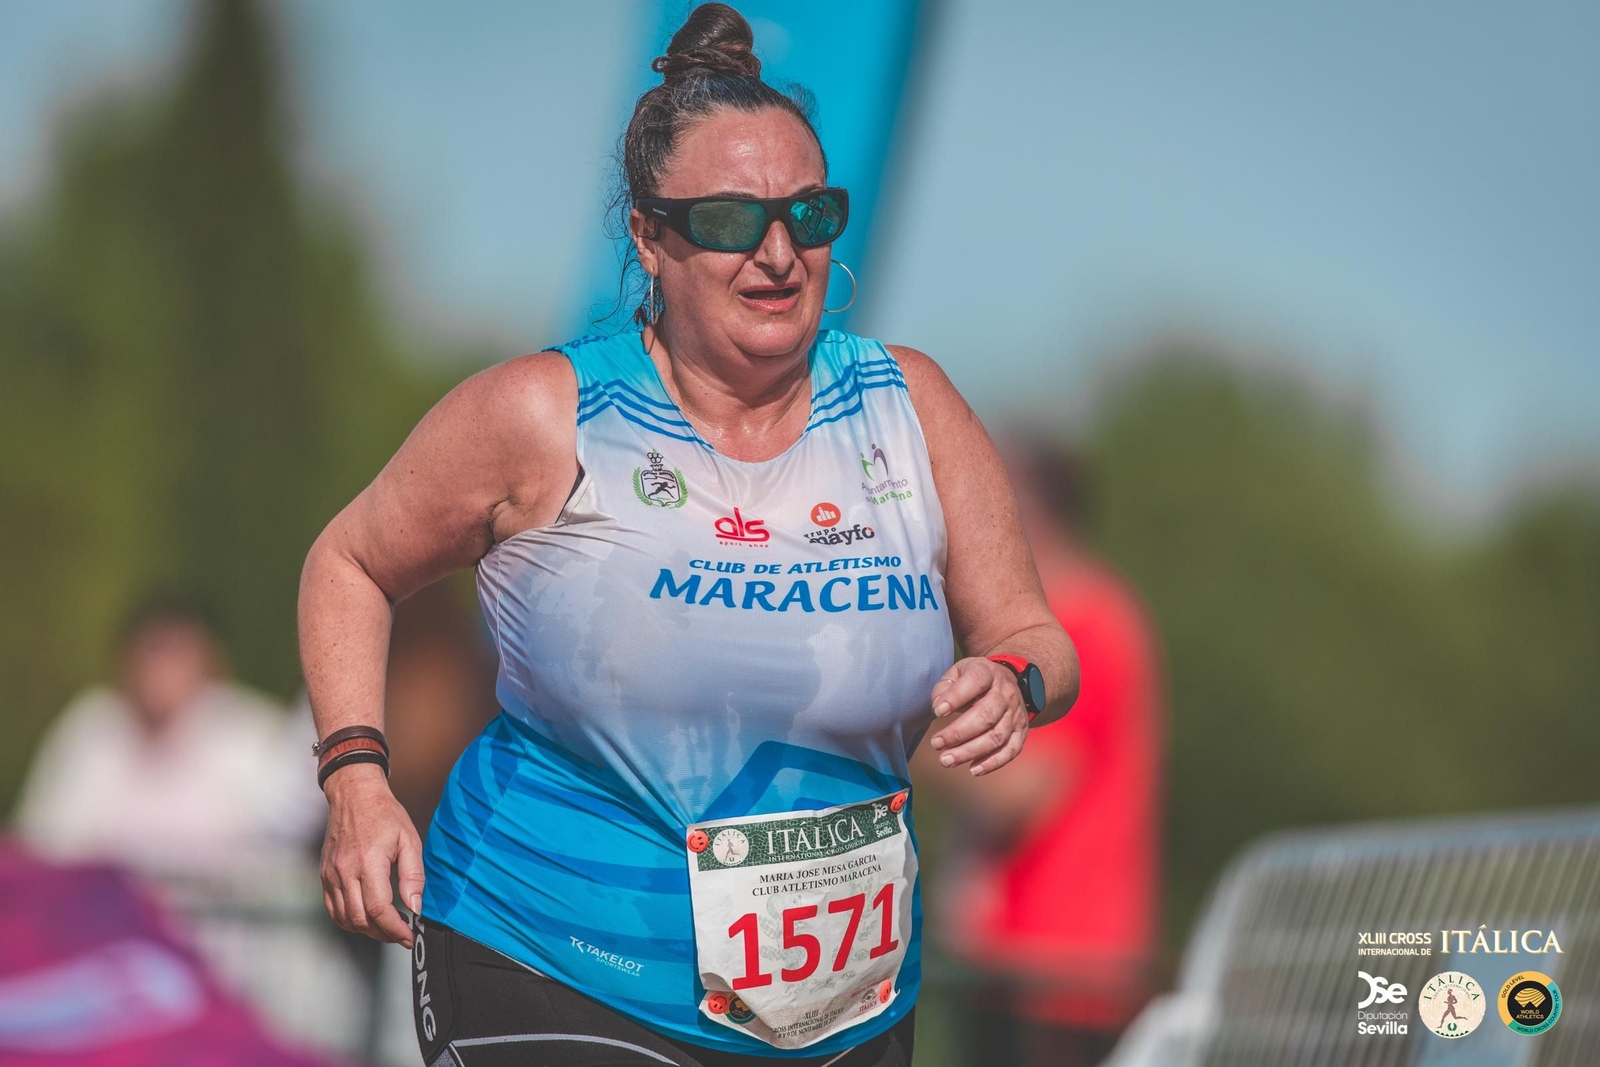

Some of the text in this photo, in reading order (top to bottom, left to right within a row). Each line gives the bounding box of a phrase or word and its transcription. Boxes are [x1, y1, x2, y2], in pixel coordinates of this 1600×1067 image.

[689, 556, 902, 575] CLUB DE ATLETISMO
[649, 568, 939, 613] MARACENA
[766, 815, 864, 855] ITÁLICA
[759, 854, 877, 884] MARIA JOSE MESA GARCIA
[768, 851, 824, 862] INTERNATIONAL
[752, 863, 882, 897] CLUB ATLETISMO MARACENA
[728, 882, 899, 991] 1571
[586, 943, 645, 973] TAKELOT
[595, 957, 640, 978] SPORTSWEAR
